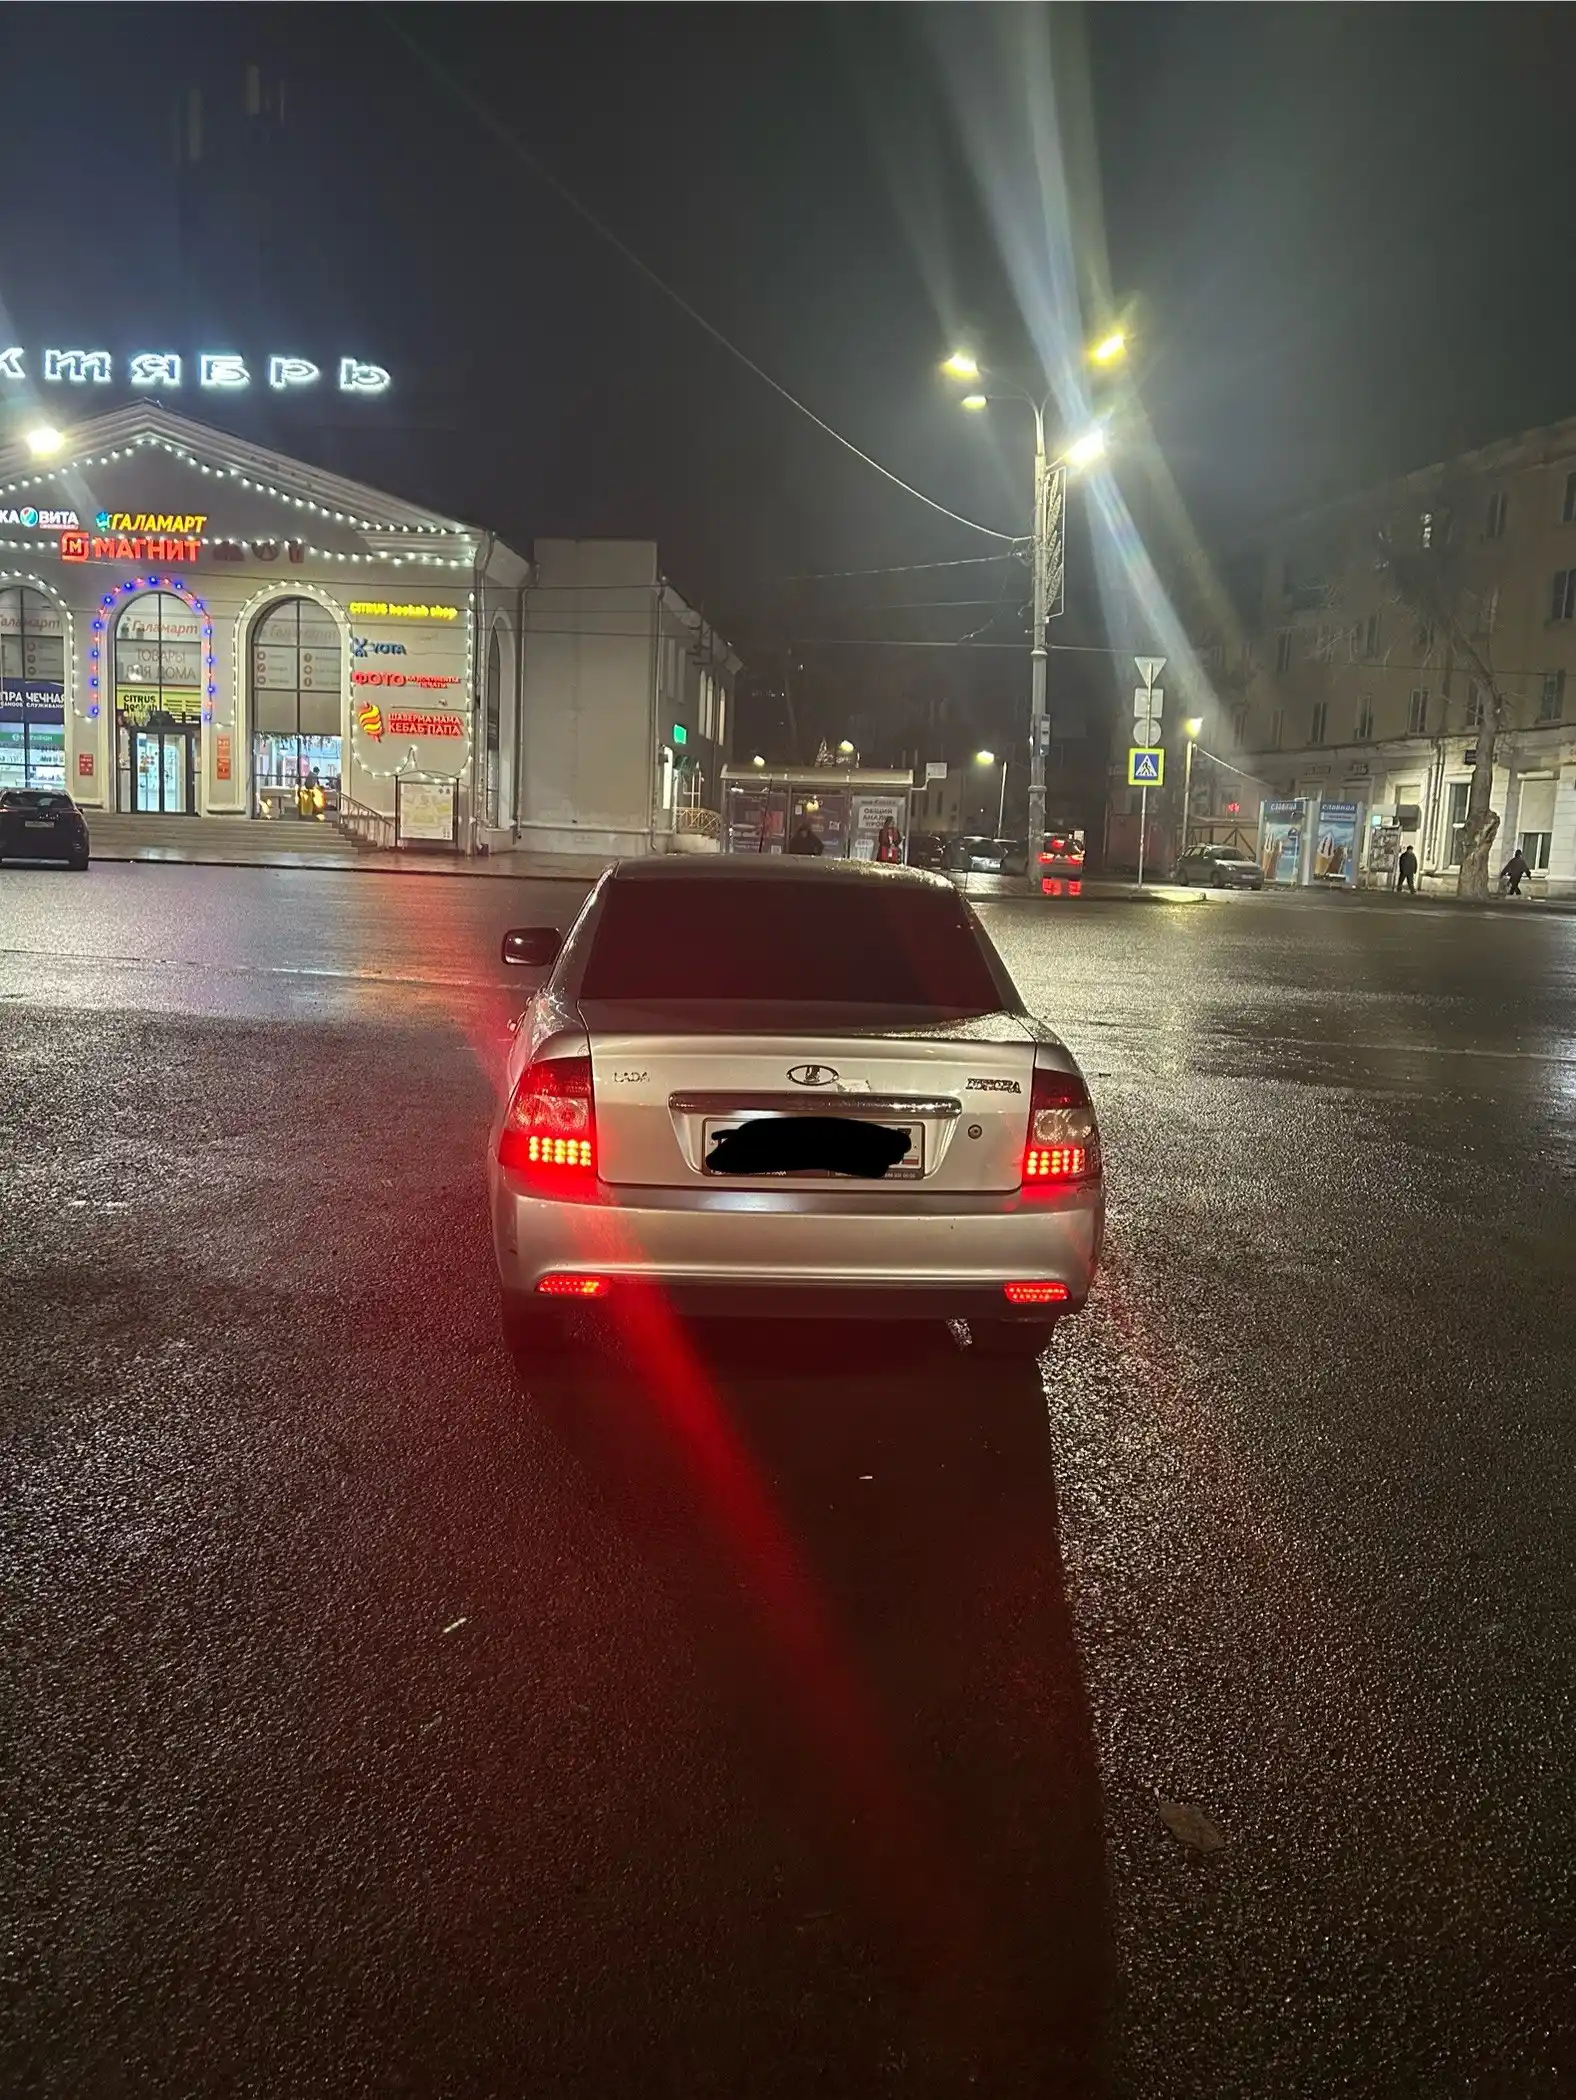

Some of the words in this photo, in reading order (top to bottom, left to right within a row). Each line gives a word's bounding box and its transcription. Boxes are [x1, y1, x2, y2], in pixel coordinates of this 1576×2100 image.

[38, 511, 79, 525] ВИТА
[111, 513, 207, 532] ГАЛАМАРТ
[95, 537, 201, 562] МАГНИТ
[349, 602, 388, 614] CITRUS
[351, 671, 407, 688] ФОТО
[123, 694, 157, 704] CITRUS
[388, 721, 426, 735] КЕБАБ
[426, 723, 464, 737] ПАПА
